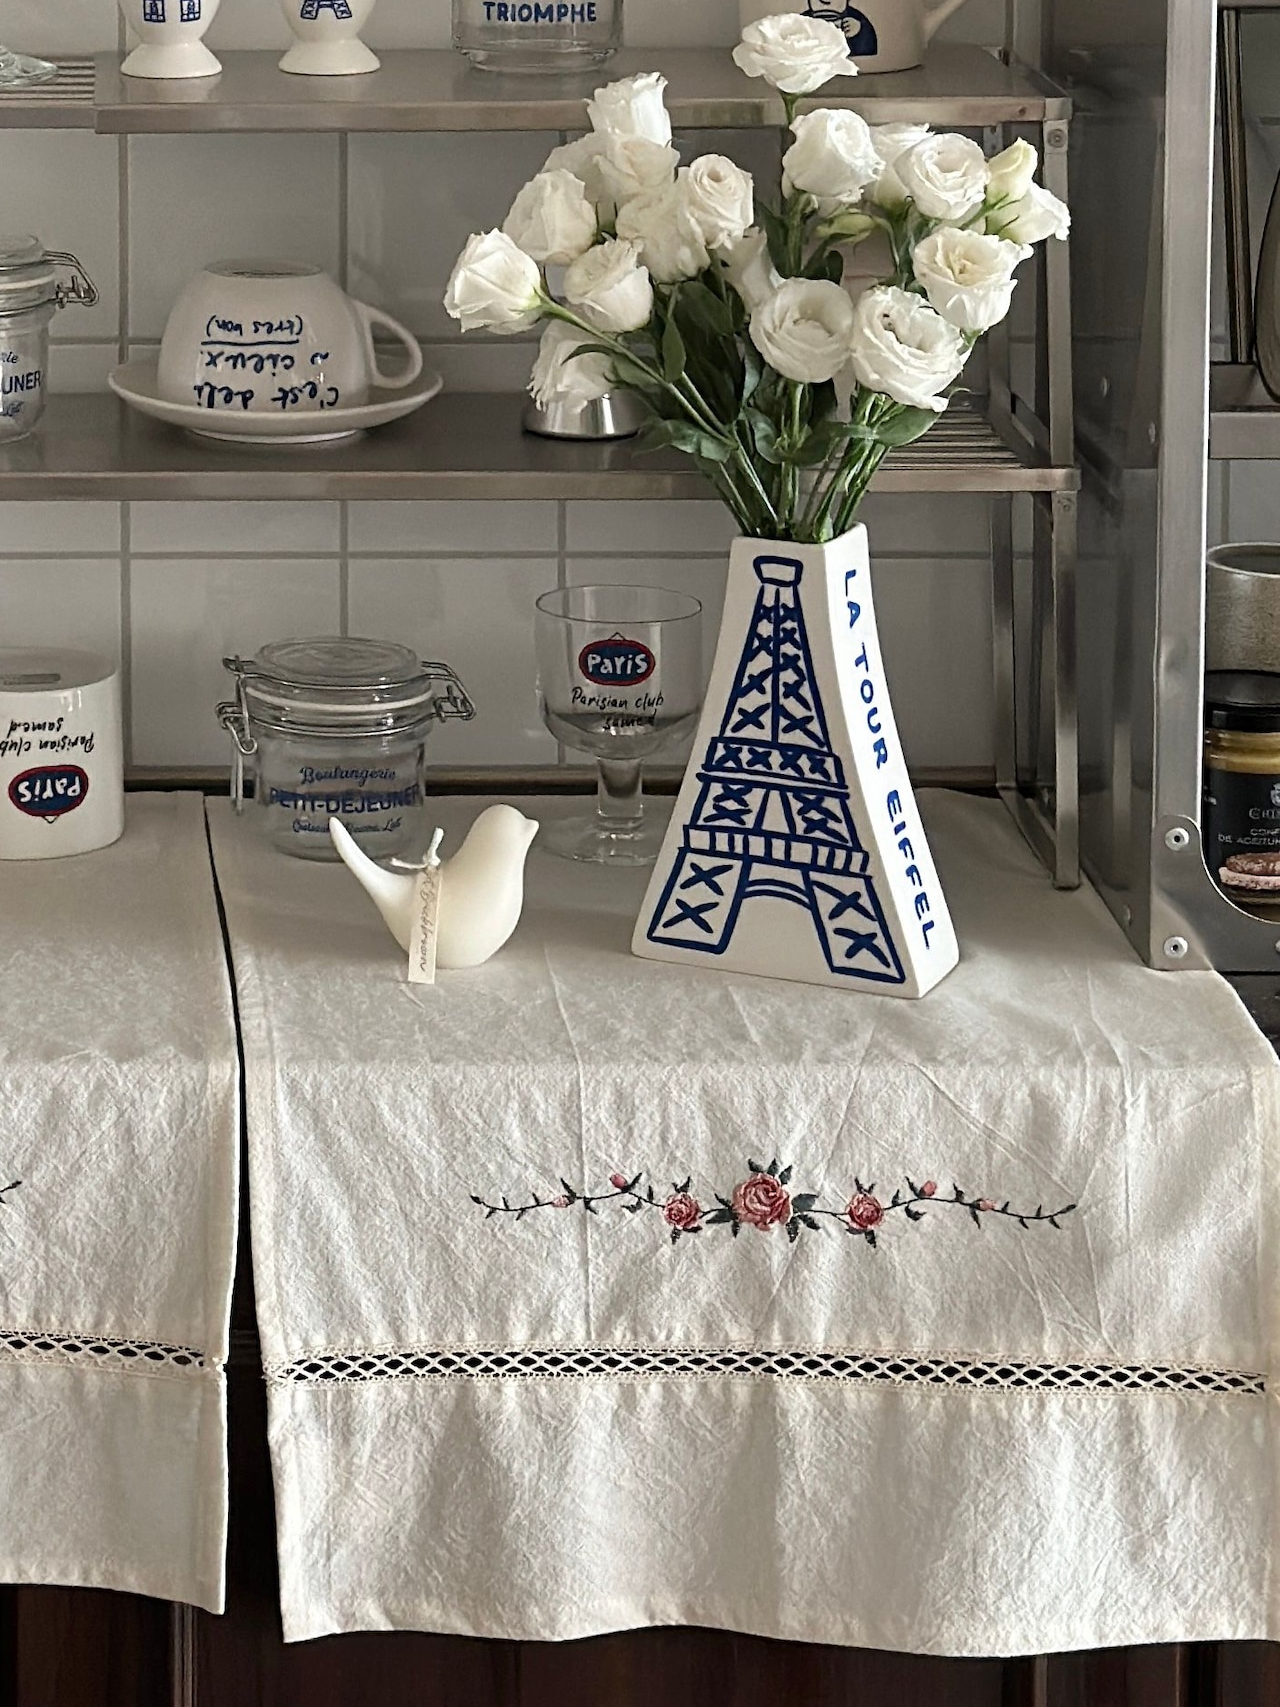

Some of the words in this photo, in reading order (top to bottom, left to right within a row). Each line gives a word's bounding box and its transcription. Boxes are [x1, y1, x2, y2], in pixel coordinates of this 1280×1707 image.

[483, 1, 597, 23] TRIOMPHE
[572, 686, 628, 710] Parisian
[635, 690, 664, 711] club
[0, 736, 32, 757] club
[39, 732, 95, 754] Parisian
[843, 569, 862, 629] LA
[854, 642, 890, 771] TOUR
[885, 789, 935, 953] EIFFEL
[299, 765, 396, 787] Boulangerie
[1218, 834, 1232, 843] DE
